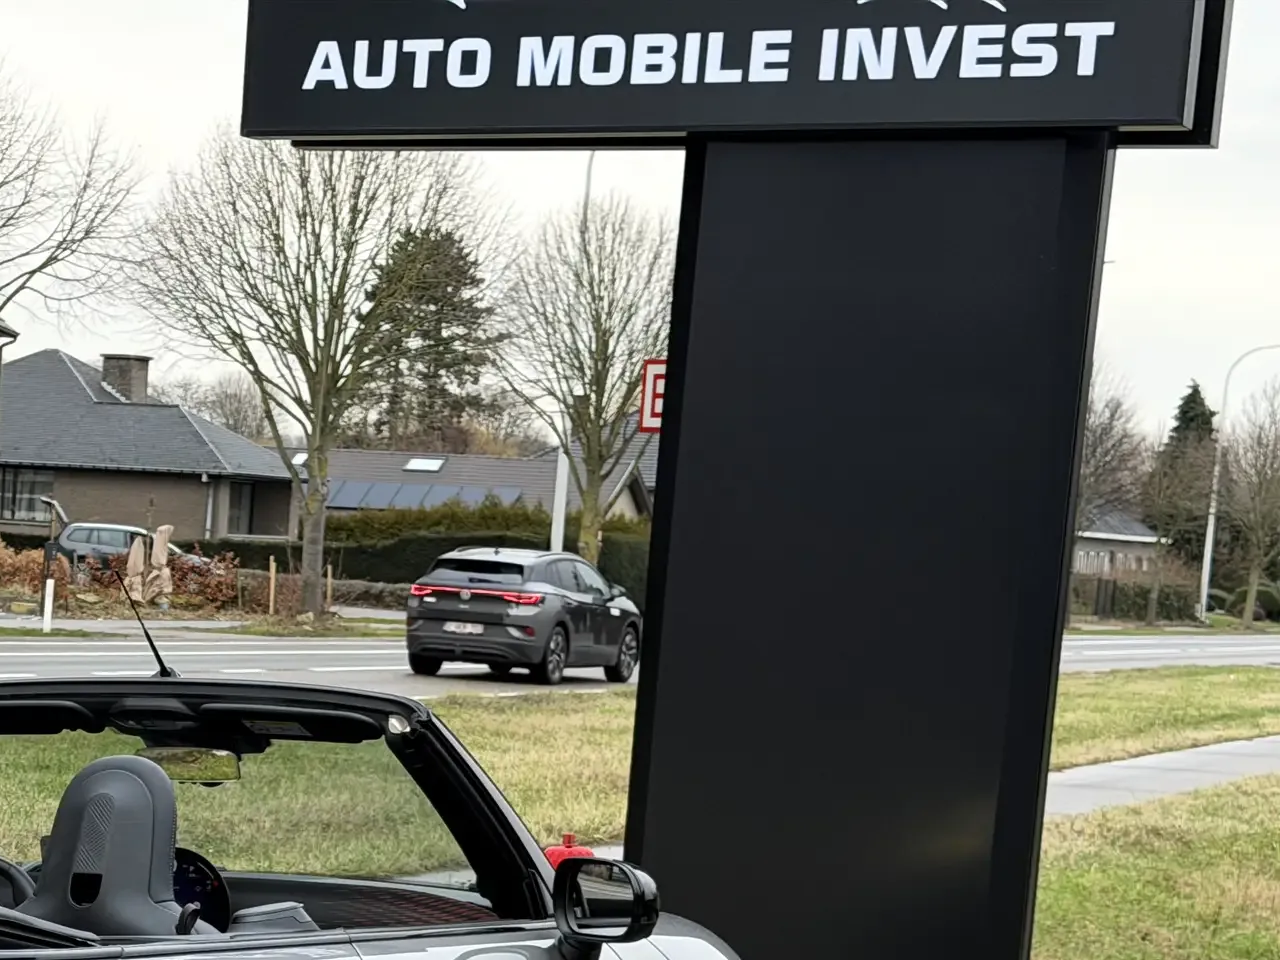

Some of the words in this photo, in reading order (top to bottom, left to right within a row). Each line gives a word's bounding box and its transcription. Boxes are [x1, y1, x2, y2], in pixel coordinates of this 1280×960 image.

[301, 37, 492, 91] AUTO
[516, 29, 793, 88] MOBILE
[818, 21, 1116, 82] INVEST
